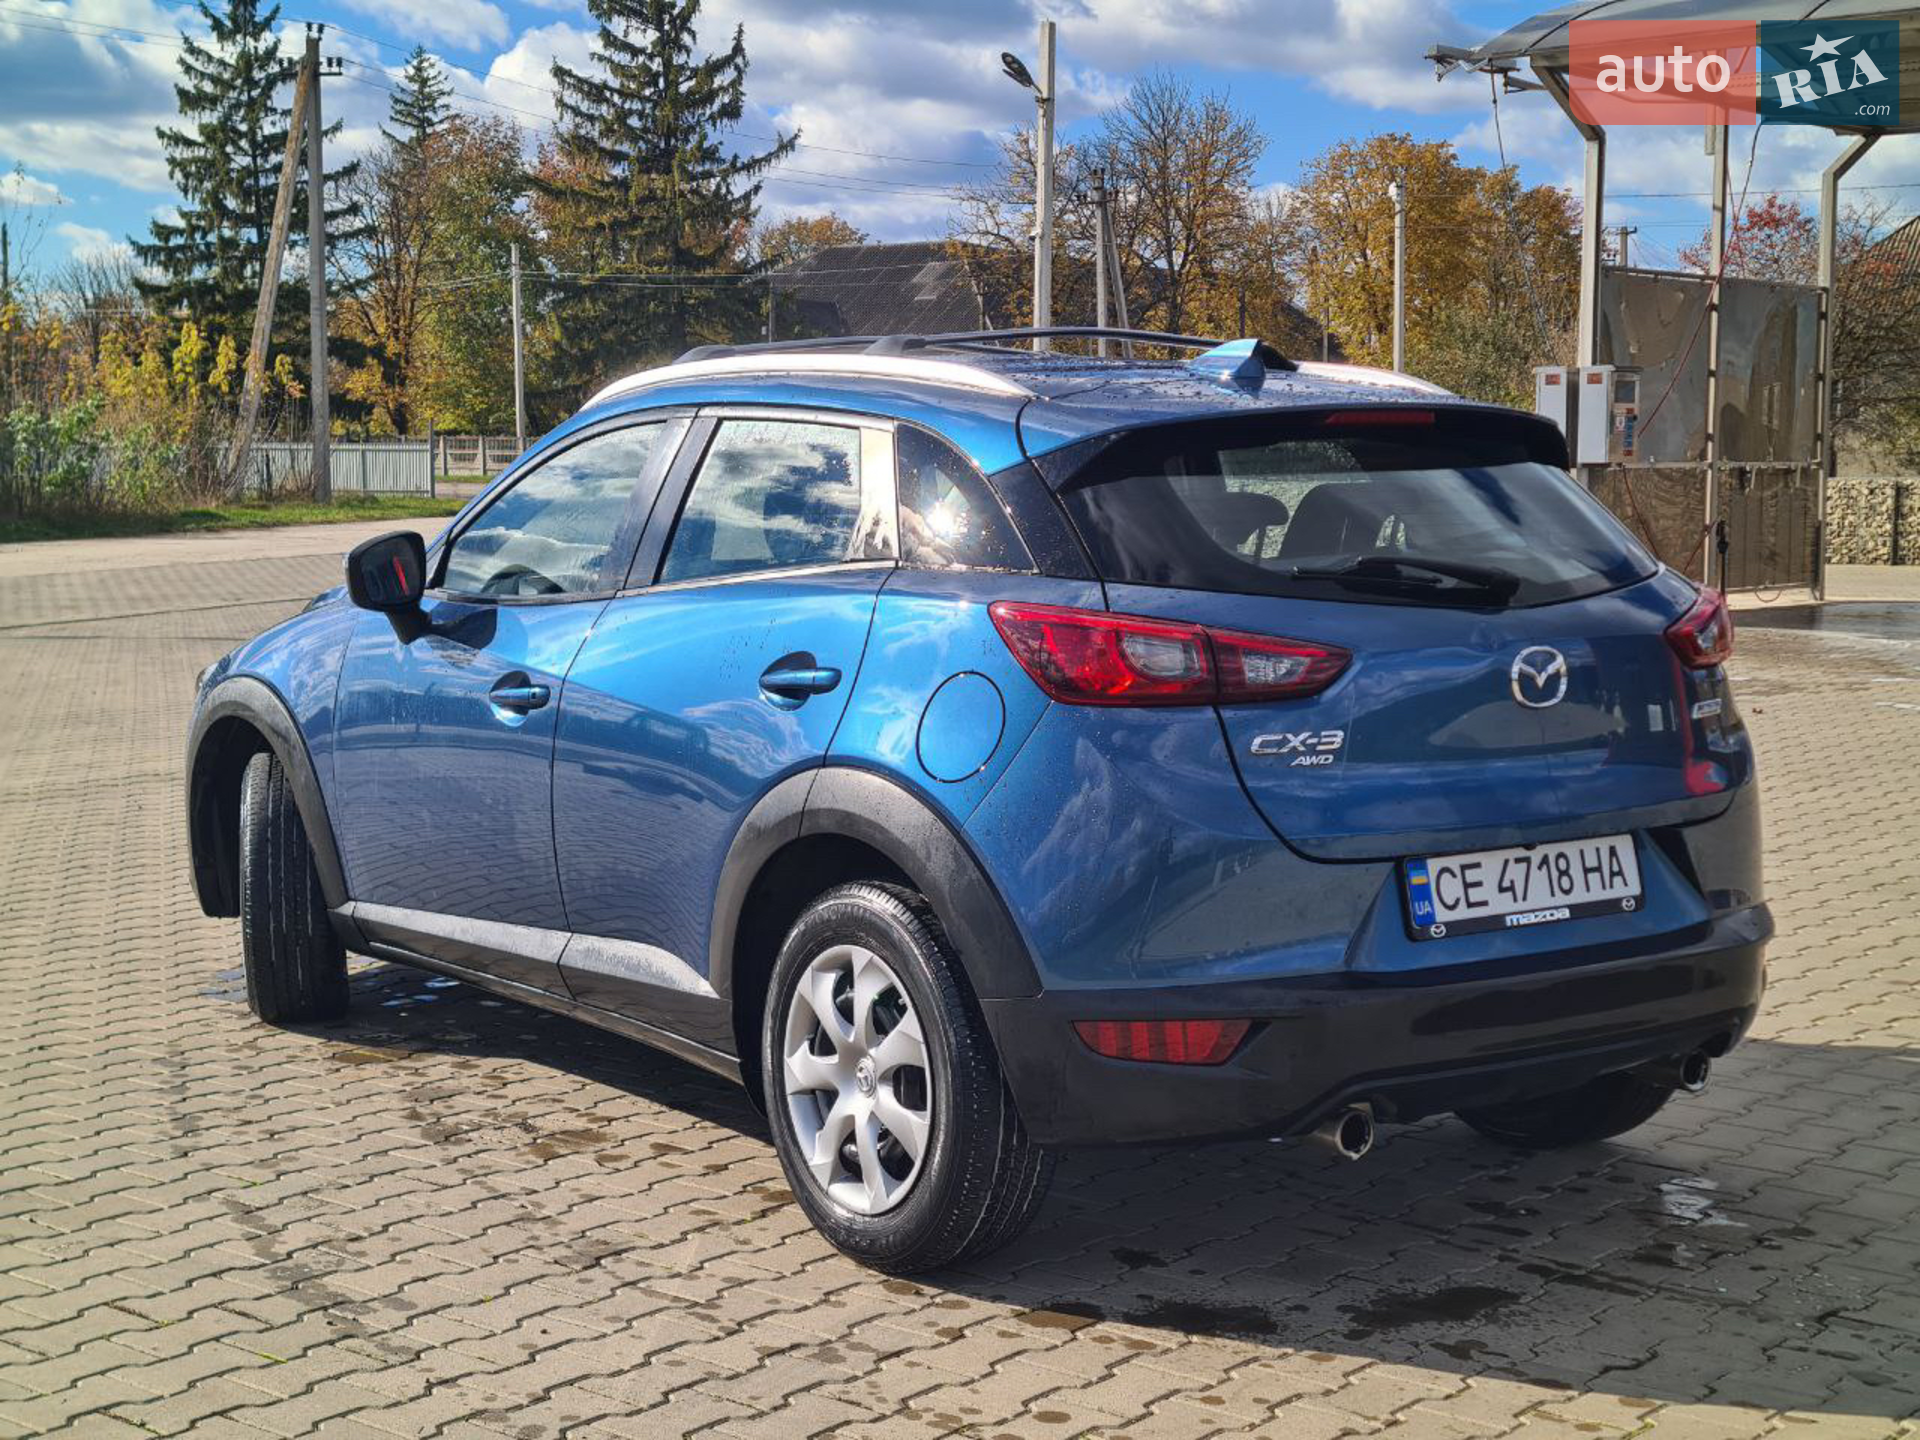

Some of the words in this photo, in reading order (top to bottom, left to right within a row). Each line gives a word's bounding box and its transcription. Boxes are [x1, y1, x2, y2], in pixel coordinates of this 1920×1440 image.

[1250, 729, 1345, 754] CX-3
[1290, 754, 1334, 766] AWD
[1434, 861, 1489, 912] CE
[1497, 851, 1575, 904] 4718
[1580, 845, 1629, 893] HA
[1414, 900, 1433, 916] UA
